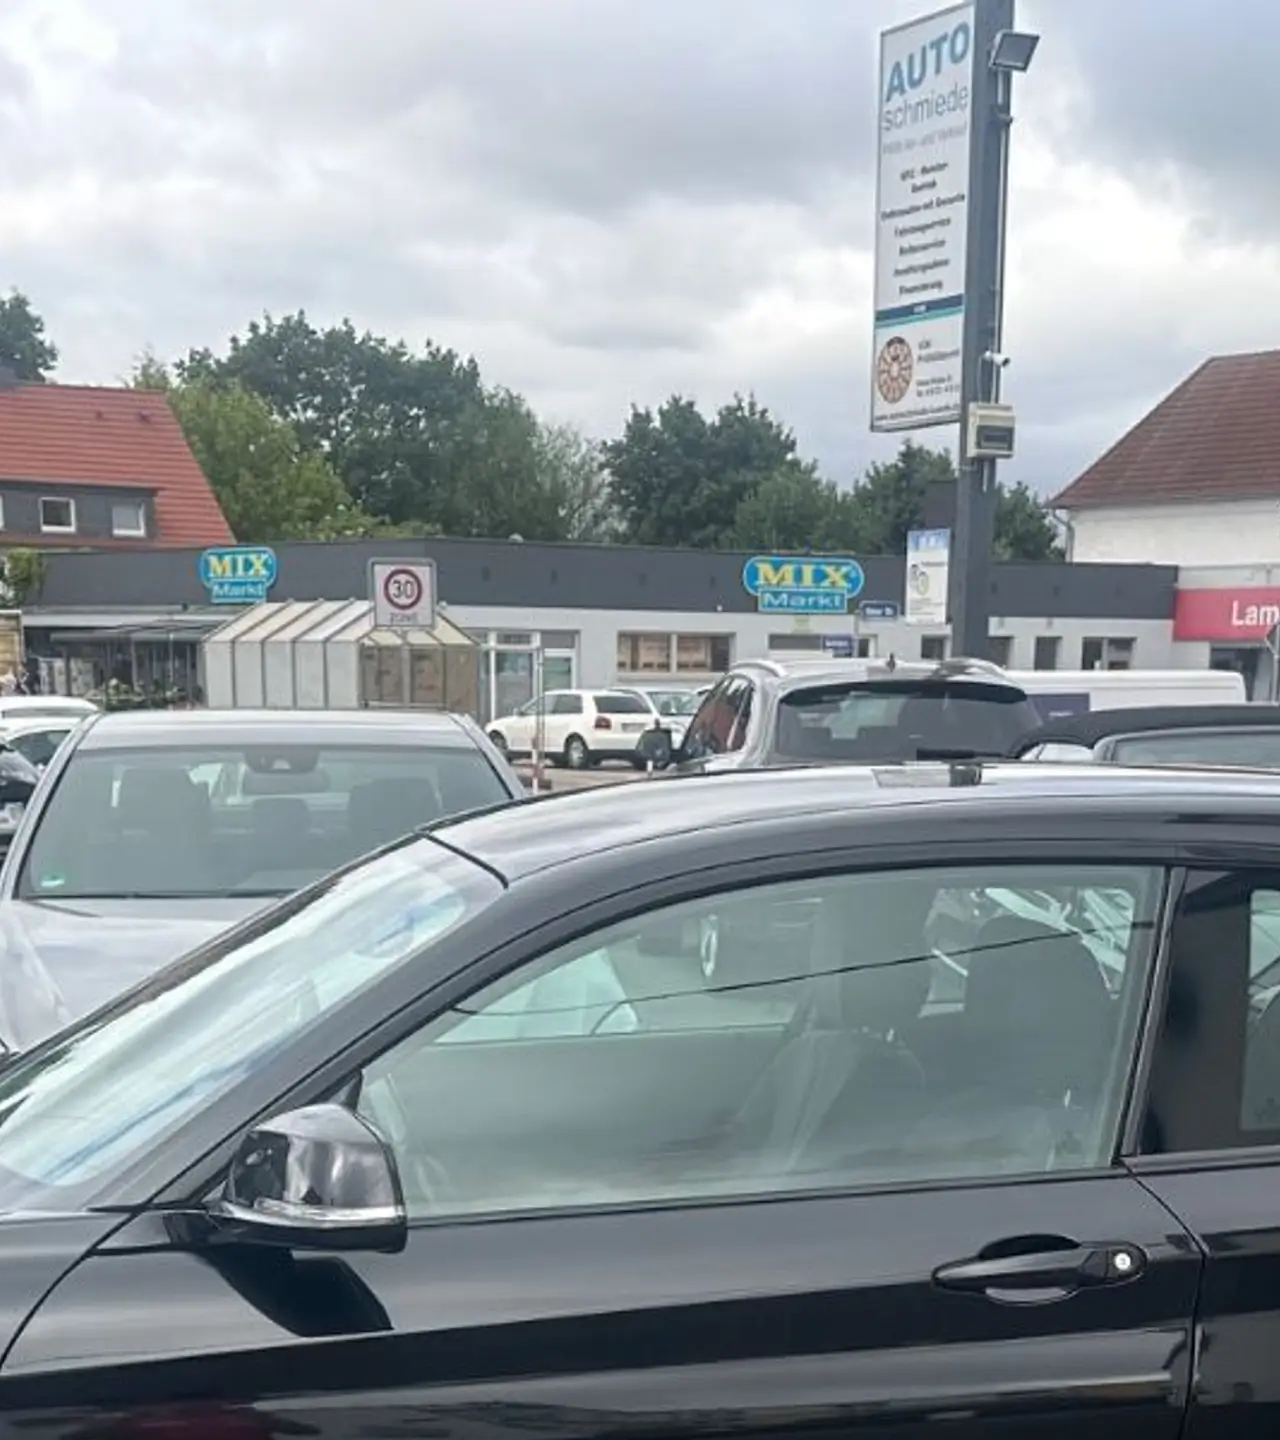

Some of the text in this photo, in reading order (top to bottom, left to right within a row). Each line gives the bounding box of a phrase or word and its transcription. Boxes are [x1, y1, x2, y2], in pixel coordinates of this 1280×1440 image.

[886, 21, 969, 102] AUTO
[881, 81, 968, 132] schmiede
[208, 553, 271, 577] MIX
[755, 562, 852, 588] MIX
[213, 582, 266, 597] Markt
[392, 580, 414, 599] 30
[763, 591, 842, 608] Markt
